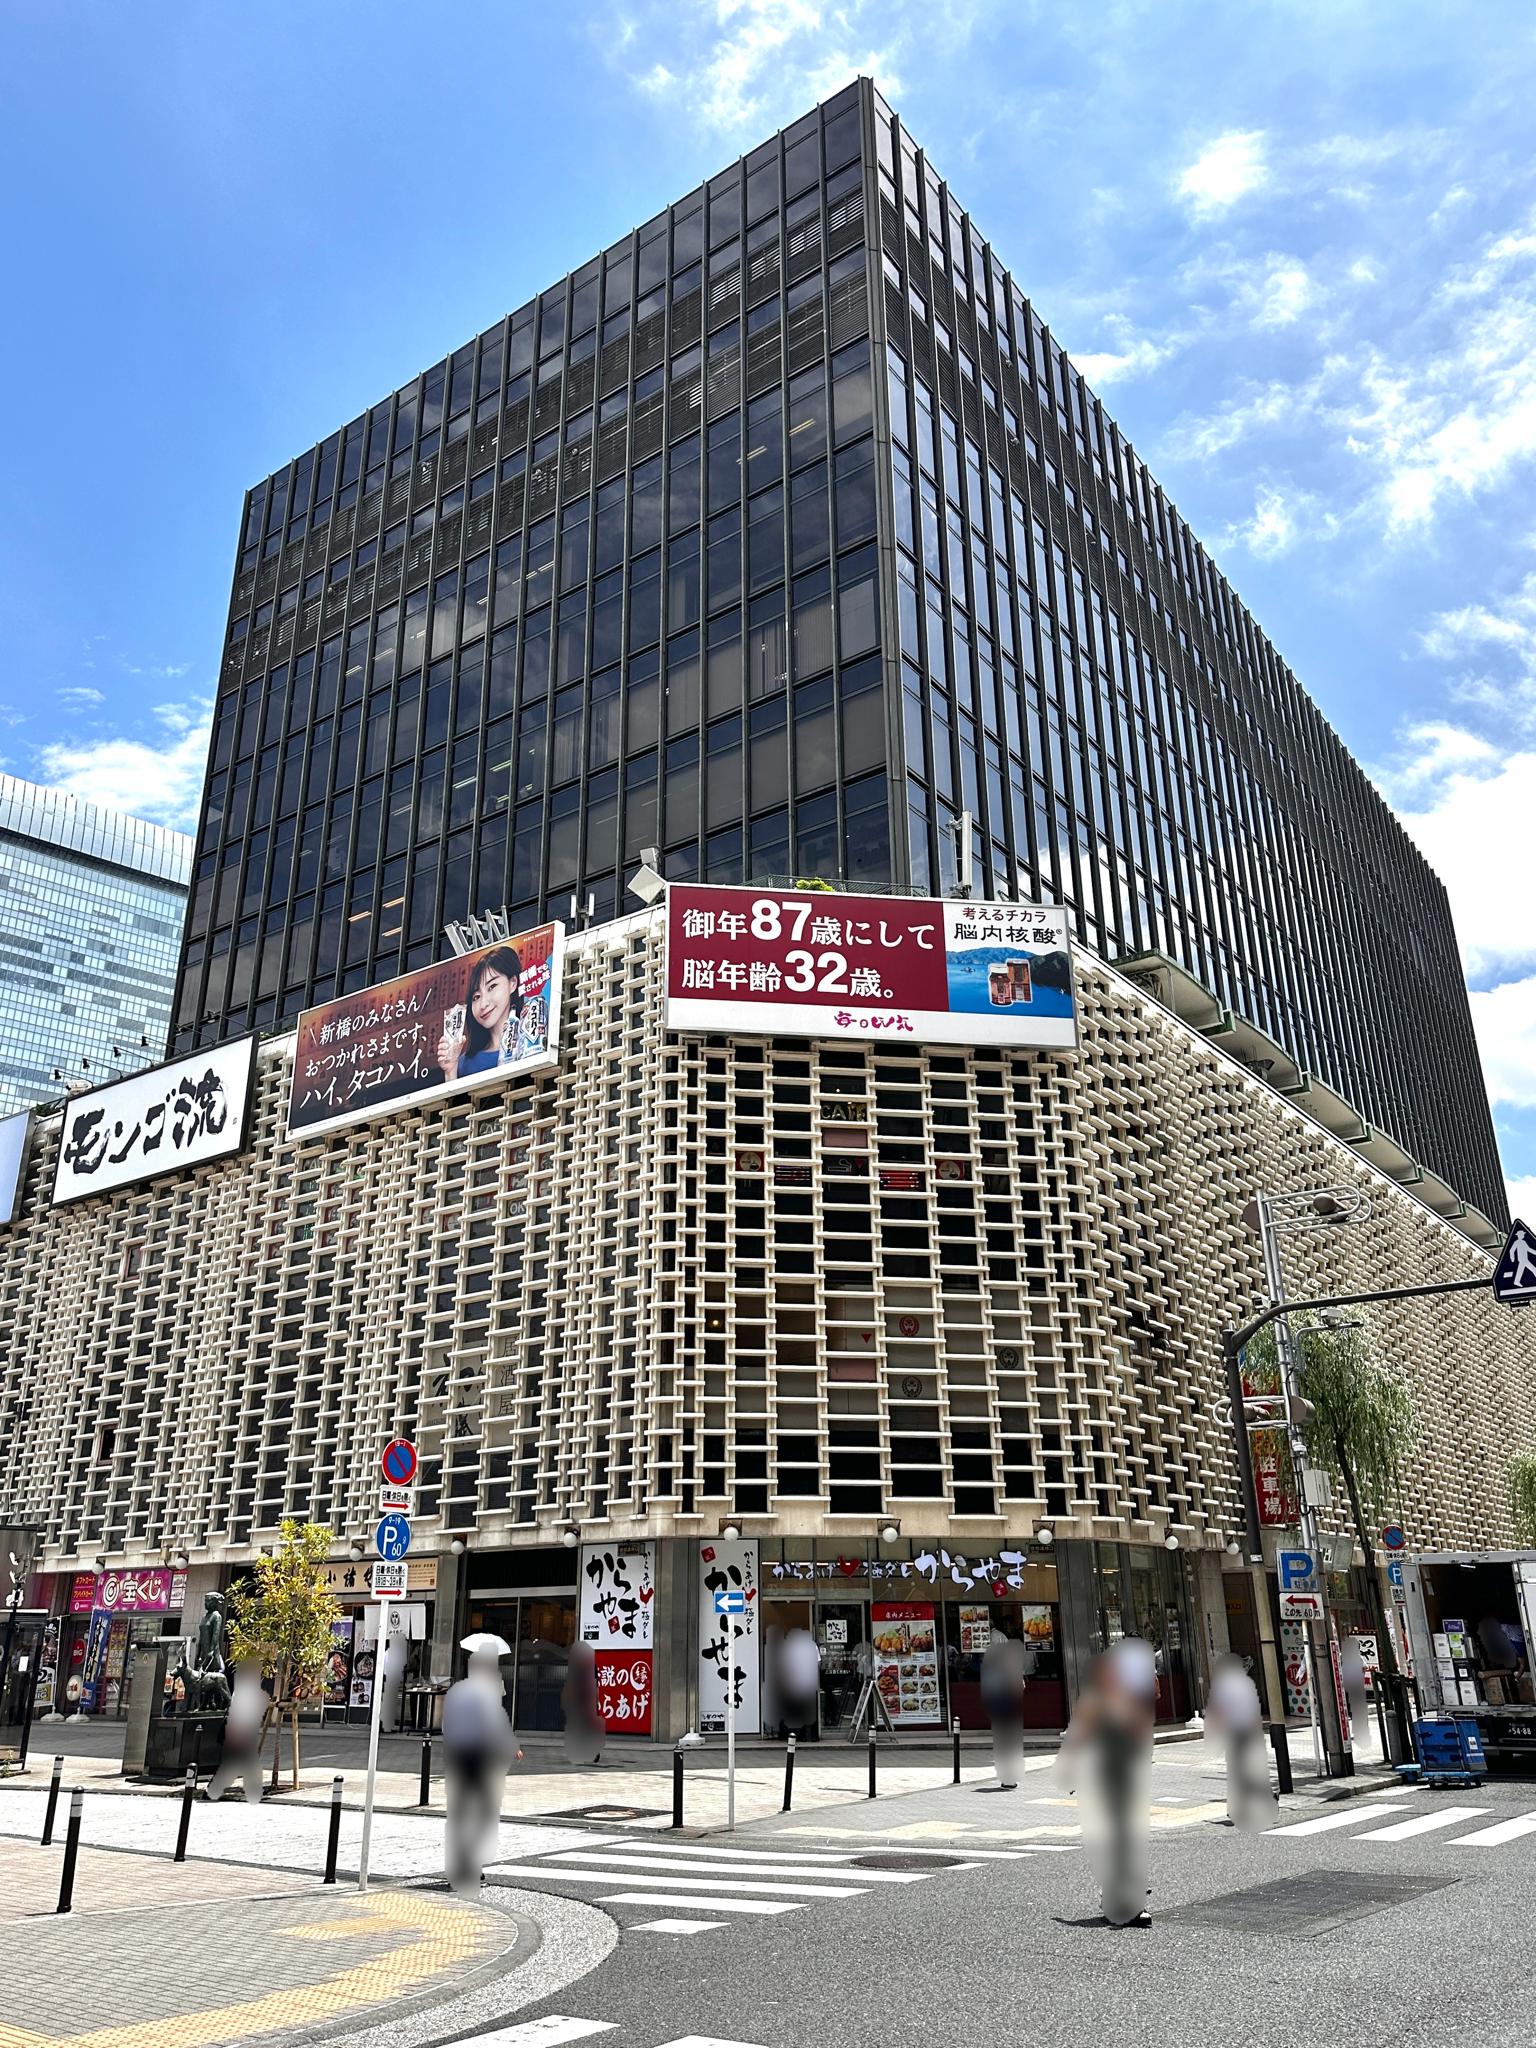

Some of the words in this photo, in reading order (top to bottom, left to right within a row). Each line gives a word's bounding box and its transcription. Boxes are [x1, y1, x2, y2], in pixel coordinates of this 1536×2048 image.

[682, 899, 935, 950] 御年87歳にして
[962, 907, 1046, 923] 考えるチカラ
[682, 950, 894, 999] 脳年齢32歳。
[300, 1048, 429, 1109] ハイ、タコハイ。
[64, 1068, 228, 1174] モンゴ流
[499, 1337, 518, 1416] 居酒屋
[1260, 1456, 1282, 1518] 駐車場
[389, 1516, 401, 1525] 9-19
[383, 1526, 398, 1555] P
[772, 1562, 835, 1581] からあげ
[863, 1560, 913, 1579] 極ダレ
[914, 1548, 1028, 1593] からやま
[1280, 1553, 1313, 1588] P
[1393, 1568, 1401, 1583] P
[122, 1578, 162, 1603] 宝くじ
[1285, 1608, 1302, 1617] この先
[598, 1661, 651, 1690] 説の縁
[598, 1692, 650, 1719] らあげ
